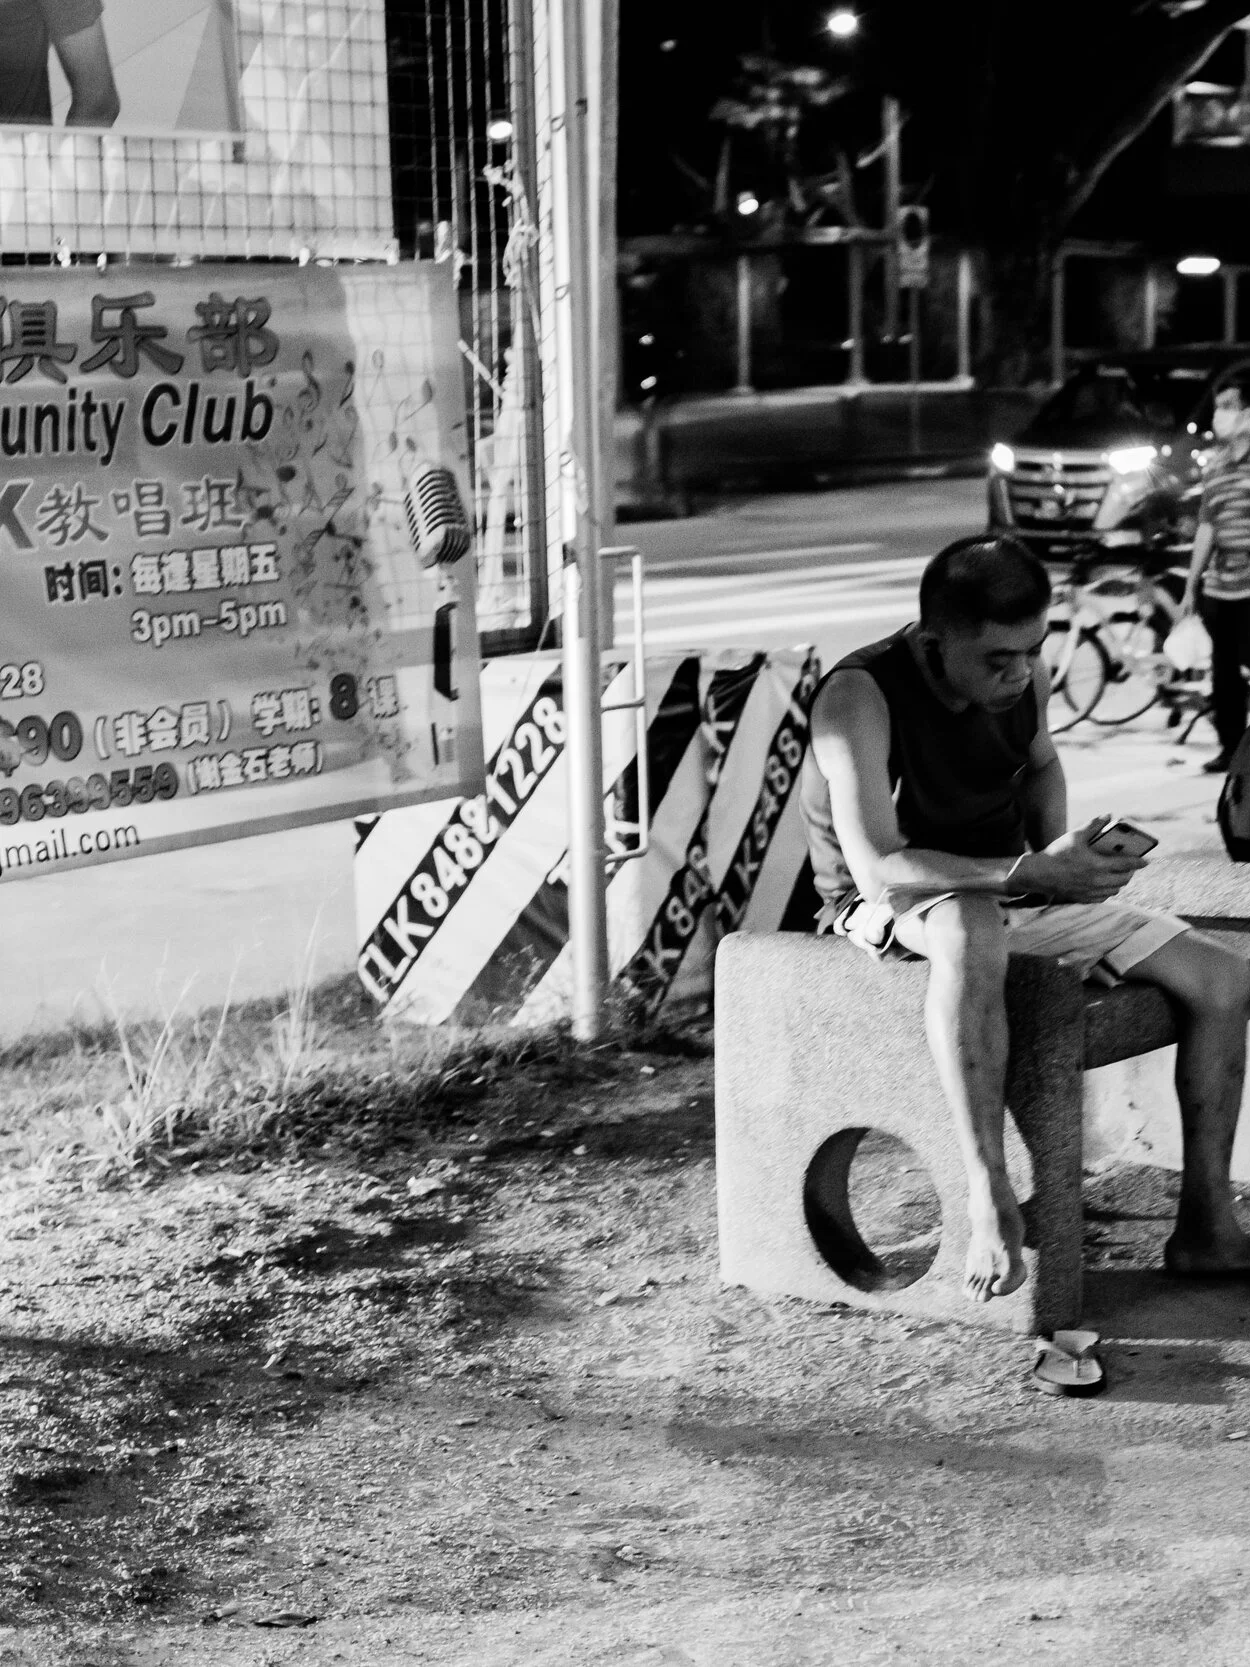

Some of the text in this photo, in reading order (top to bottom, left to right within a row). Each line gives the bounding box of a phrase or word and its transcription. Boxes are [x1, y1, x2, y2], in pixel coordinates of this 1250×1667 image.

[0, 291, 280, 384] 俱乐部
[1, 380, 273, 466] unity Club
[131, 600, 287, 648] 3pm-5pm
[0, 660, 44, 699] 28
[329, 672, 359, 721] 8
[0, 824, 141, 878] mail.com
